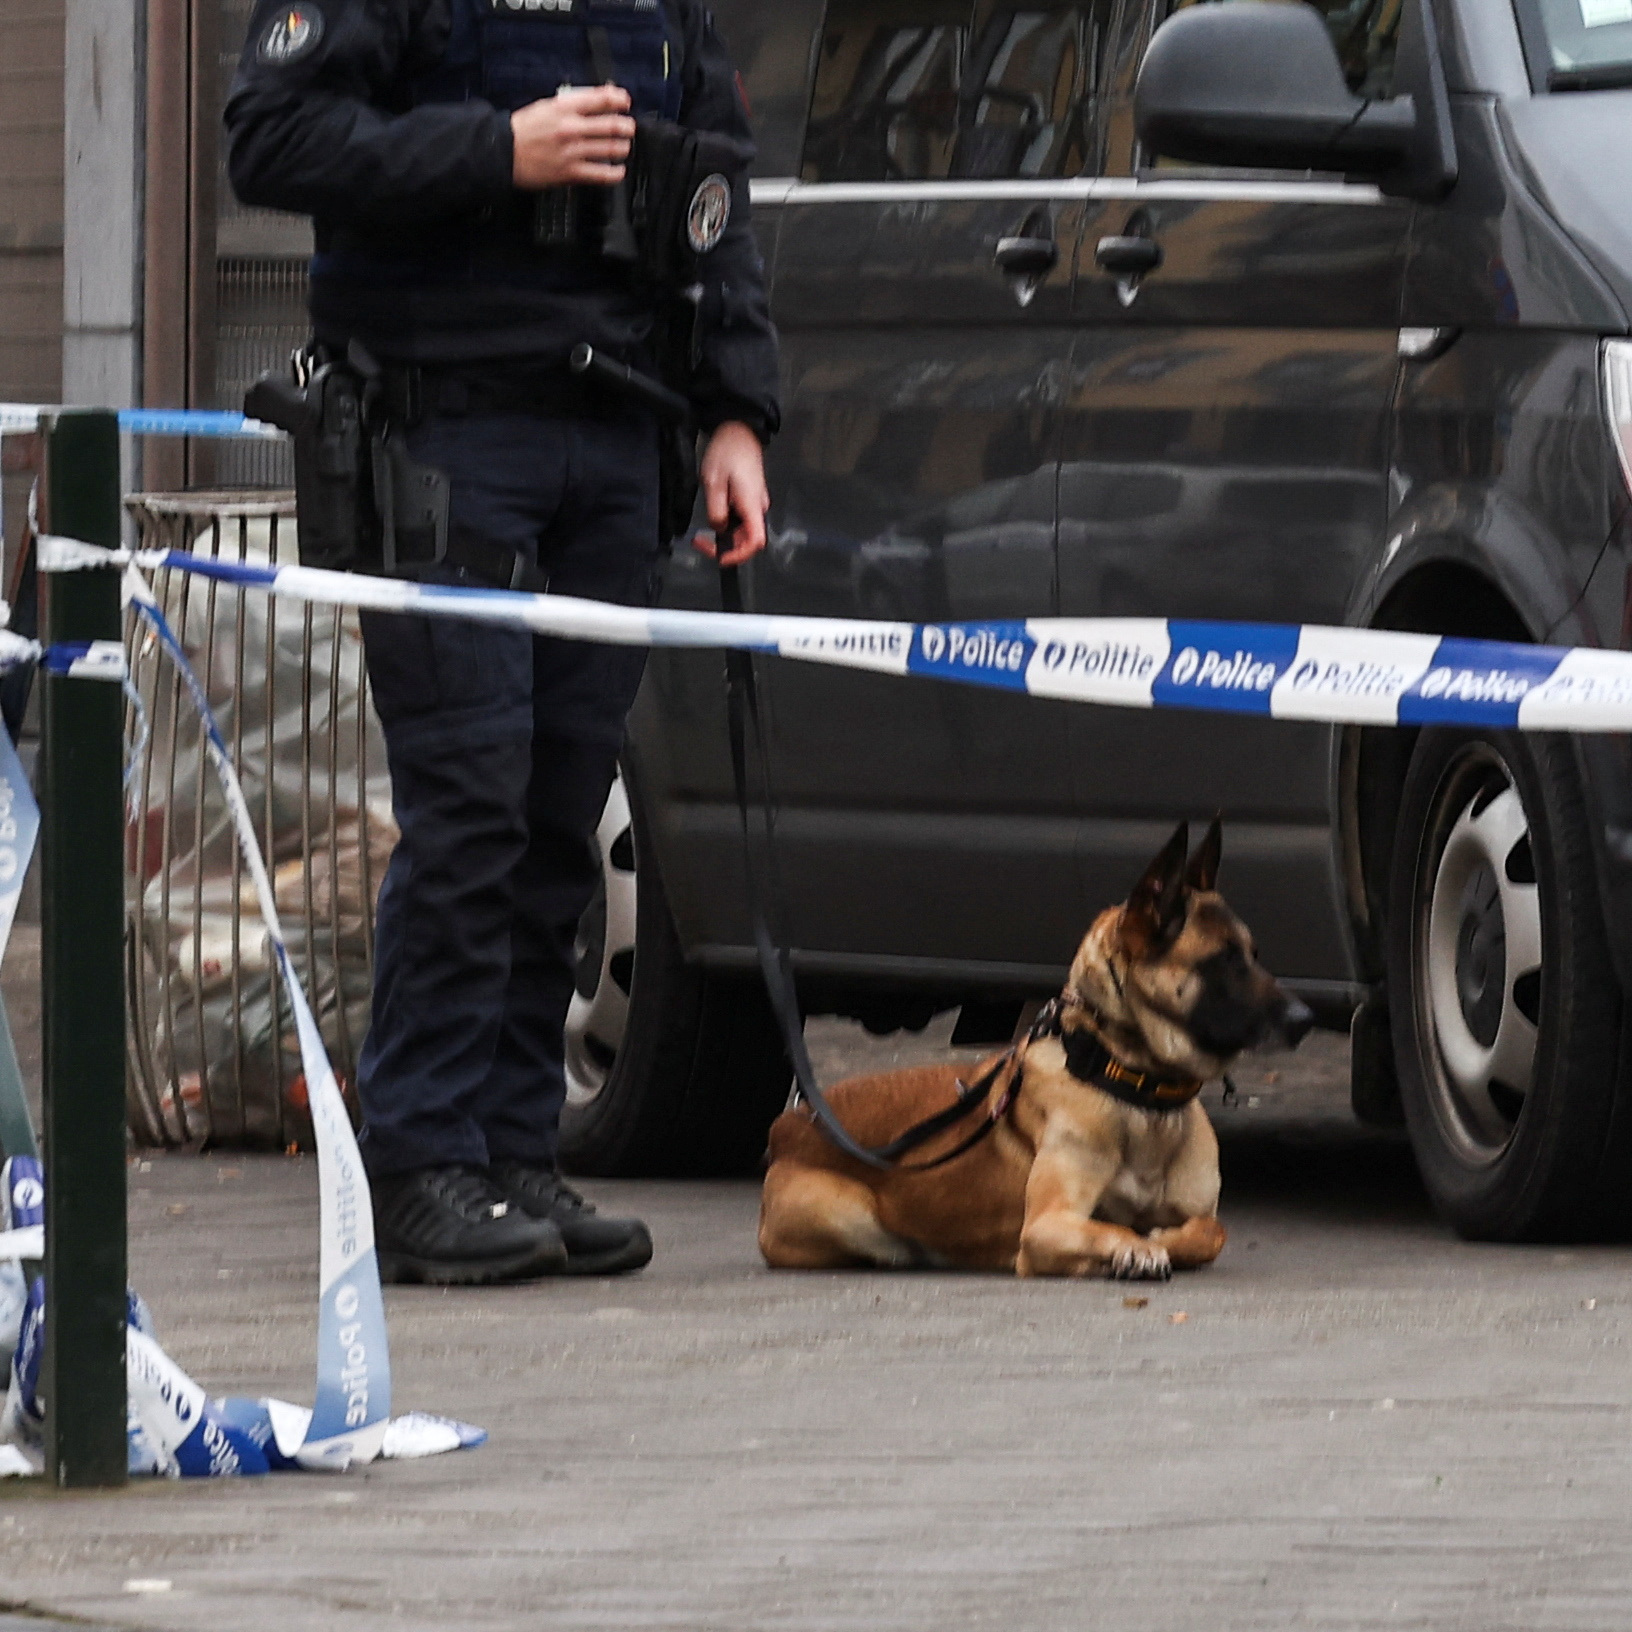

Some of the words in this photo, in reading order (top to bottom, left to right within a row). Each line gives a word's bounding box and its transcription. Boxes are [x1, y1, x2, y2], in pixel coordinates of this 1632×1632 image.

[948, 628, 1024, 672] Police
[1071, 644, 1154, 680] Politie
[1195, 650, 1277, 691] Police
